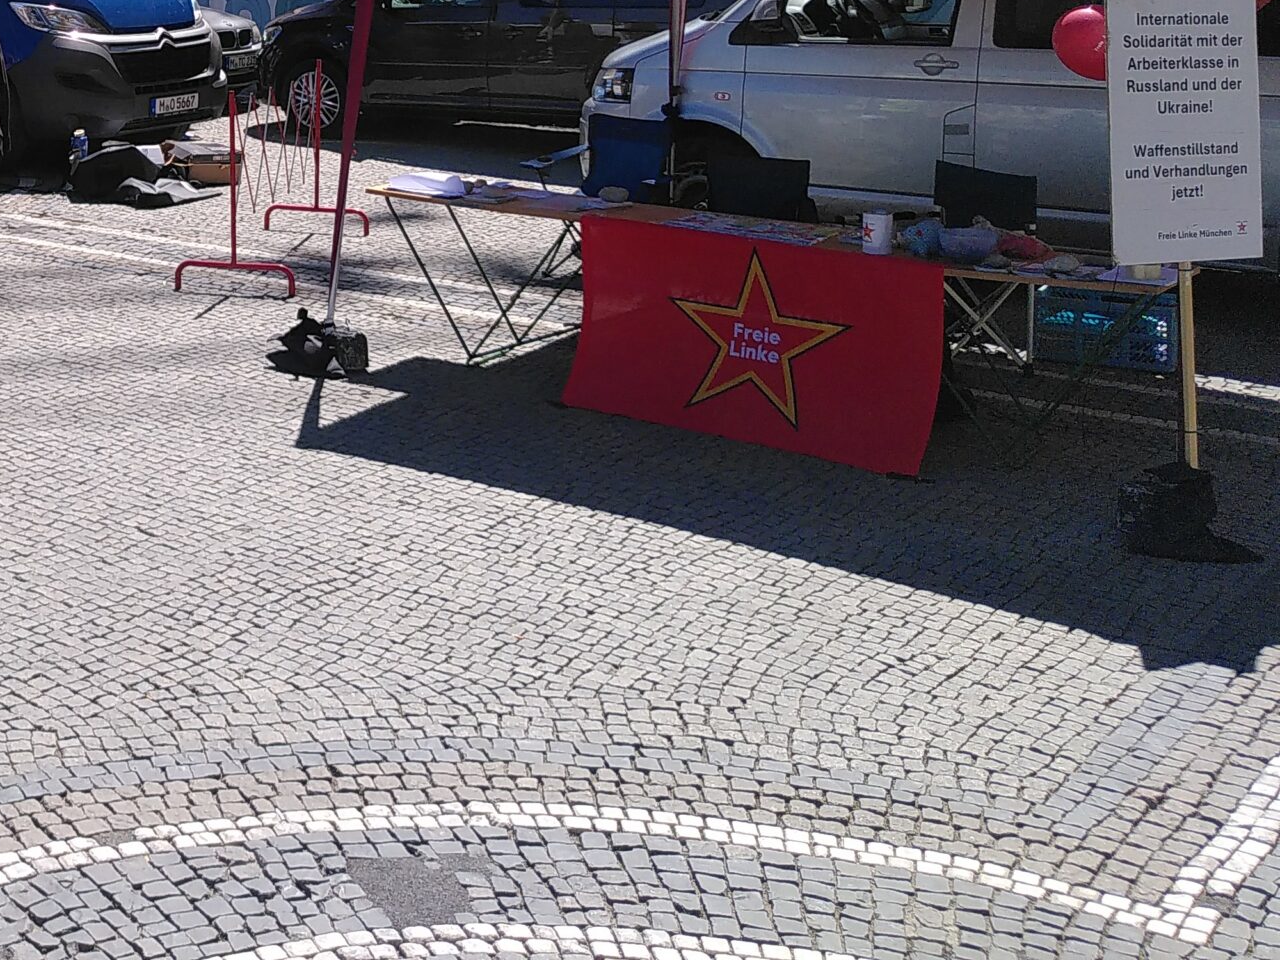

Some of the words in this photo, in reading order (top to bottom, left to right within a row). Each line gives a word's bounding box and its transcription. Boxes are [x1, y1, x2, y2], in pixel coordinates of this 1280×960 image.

[1136, 12, 1229, 26] Internationale
[1123, 34, 1192, 49] Solidarität
[1196, 35, 1218, 48] mit
[1221, 34, 1243, 48] der
[1127, 56, 1224, 71] Arbeiterklasse
[1227, 56, 1239, 69] in
[1127, 78, 1188, 93] Russland
[1192, 78, 1217, 92] und
[1220, 77, 1242, 91] der
[1157, 100, 1213, 114] Ukraine!
[1134, 142, 1238, 158] Waffenstillstand
[1125, 165, 1150, 179] und
[1153, 163, 1248, 179] Verhandlungen
[1171, 184, 1204, 201] jetzt!
[1158, 230, 1177, 240] Freie
[1178, 229, 1197, 239] Linke
[1199, 228, 1233, 238] München
[733, 323, 781, 345] Freie
[729, 340, 780, 364] Linke
